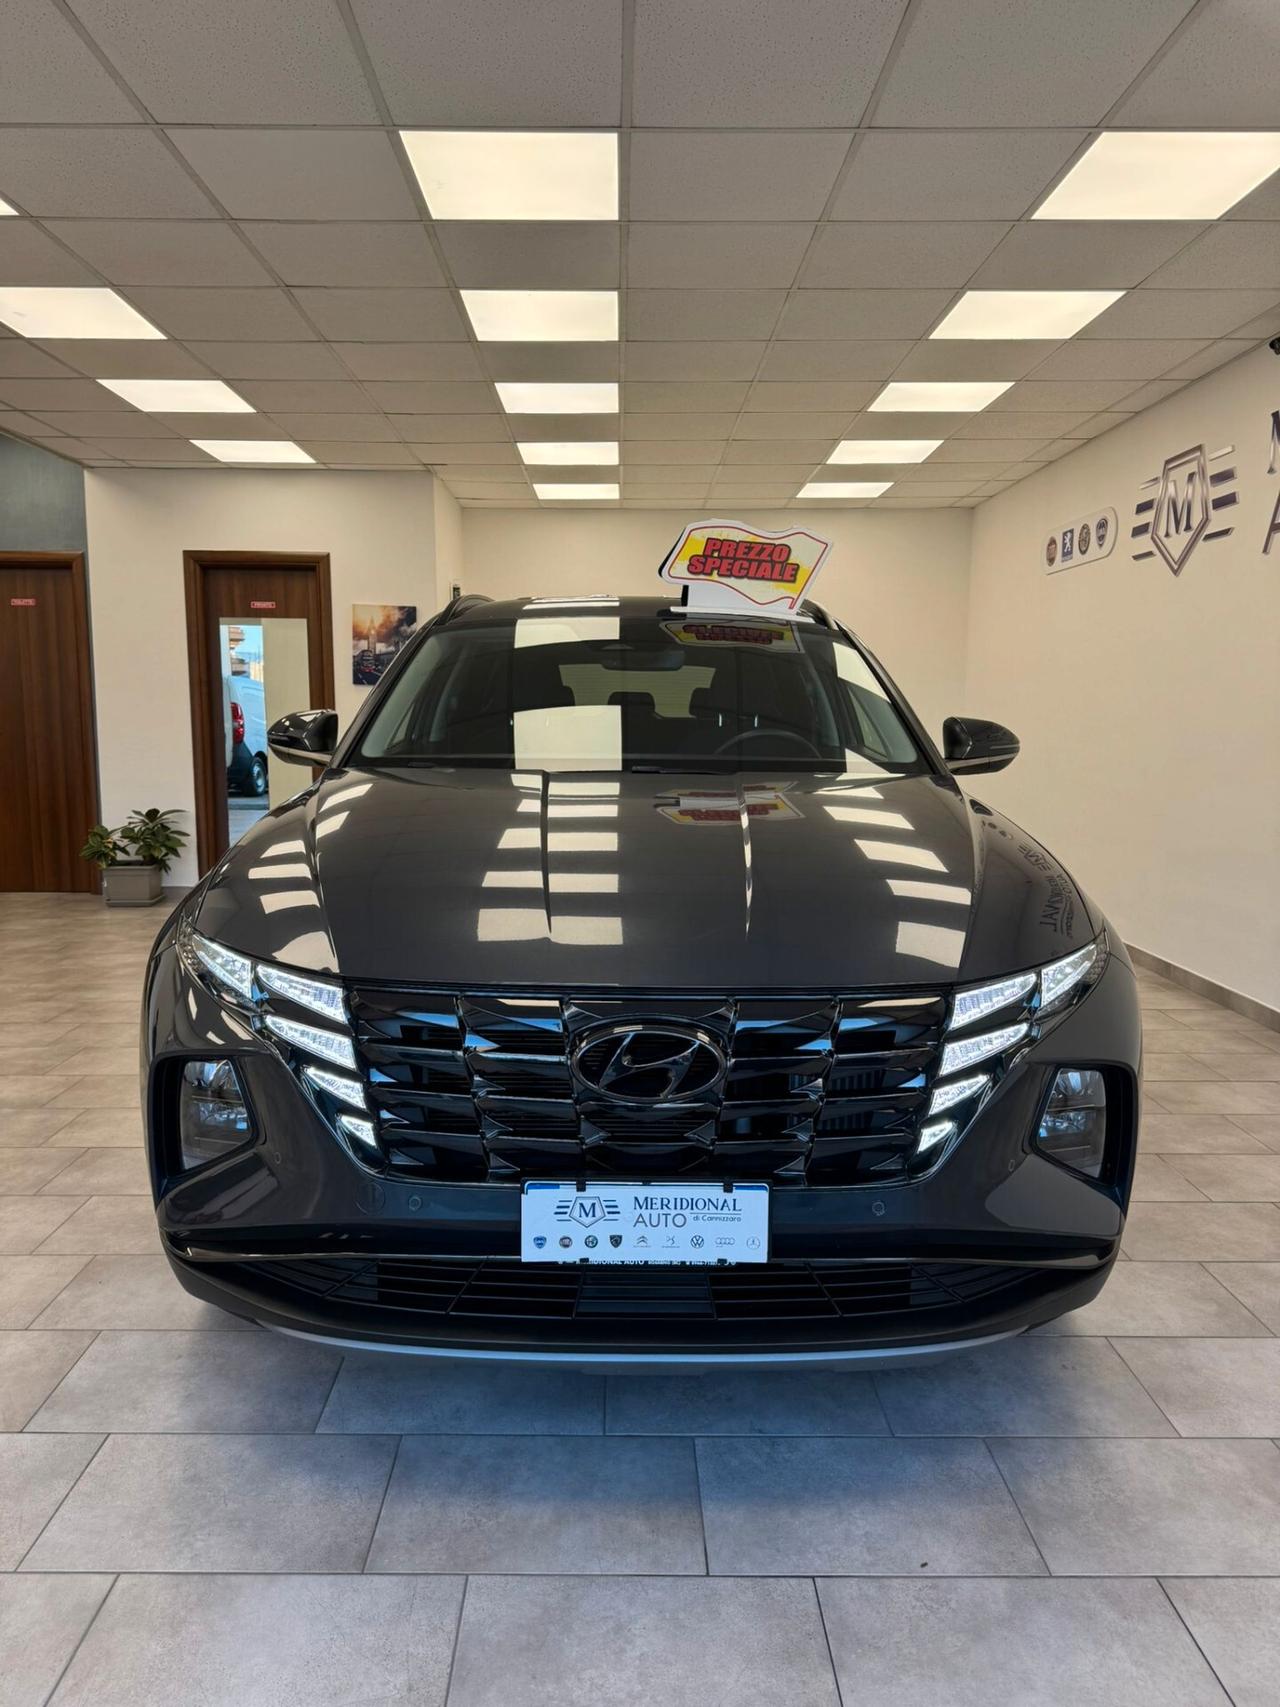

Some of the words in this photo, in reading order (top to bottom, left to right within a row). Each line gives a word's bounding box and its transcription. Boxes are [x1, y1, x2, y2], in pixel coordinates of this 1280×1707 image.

[1164, 471, 1197, 538] M
[703, 537, 791, 562] PREZZO
[687, 554, 799, 583] SPECIALE
[578, 1202, 597, 1218] M
[633, 1196, 742, 1212] MERIDIONAL
[633, 1213, 687, 1228] AUTO
[702, 1215, 742, 1223] Cannizzaro
